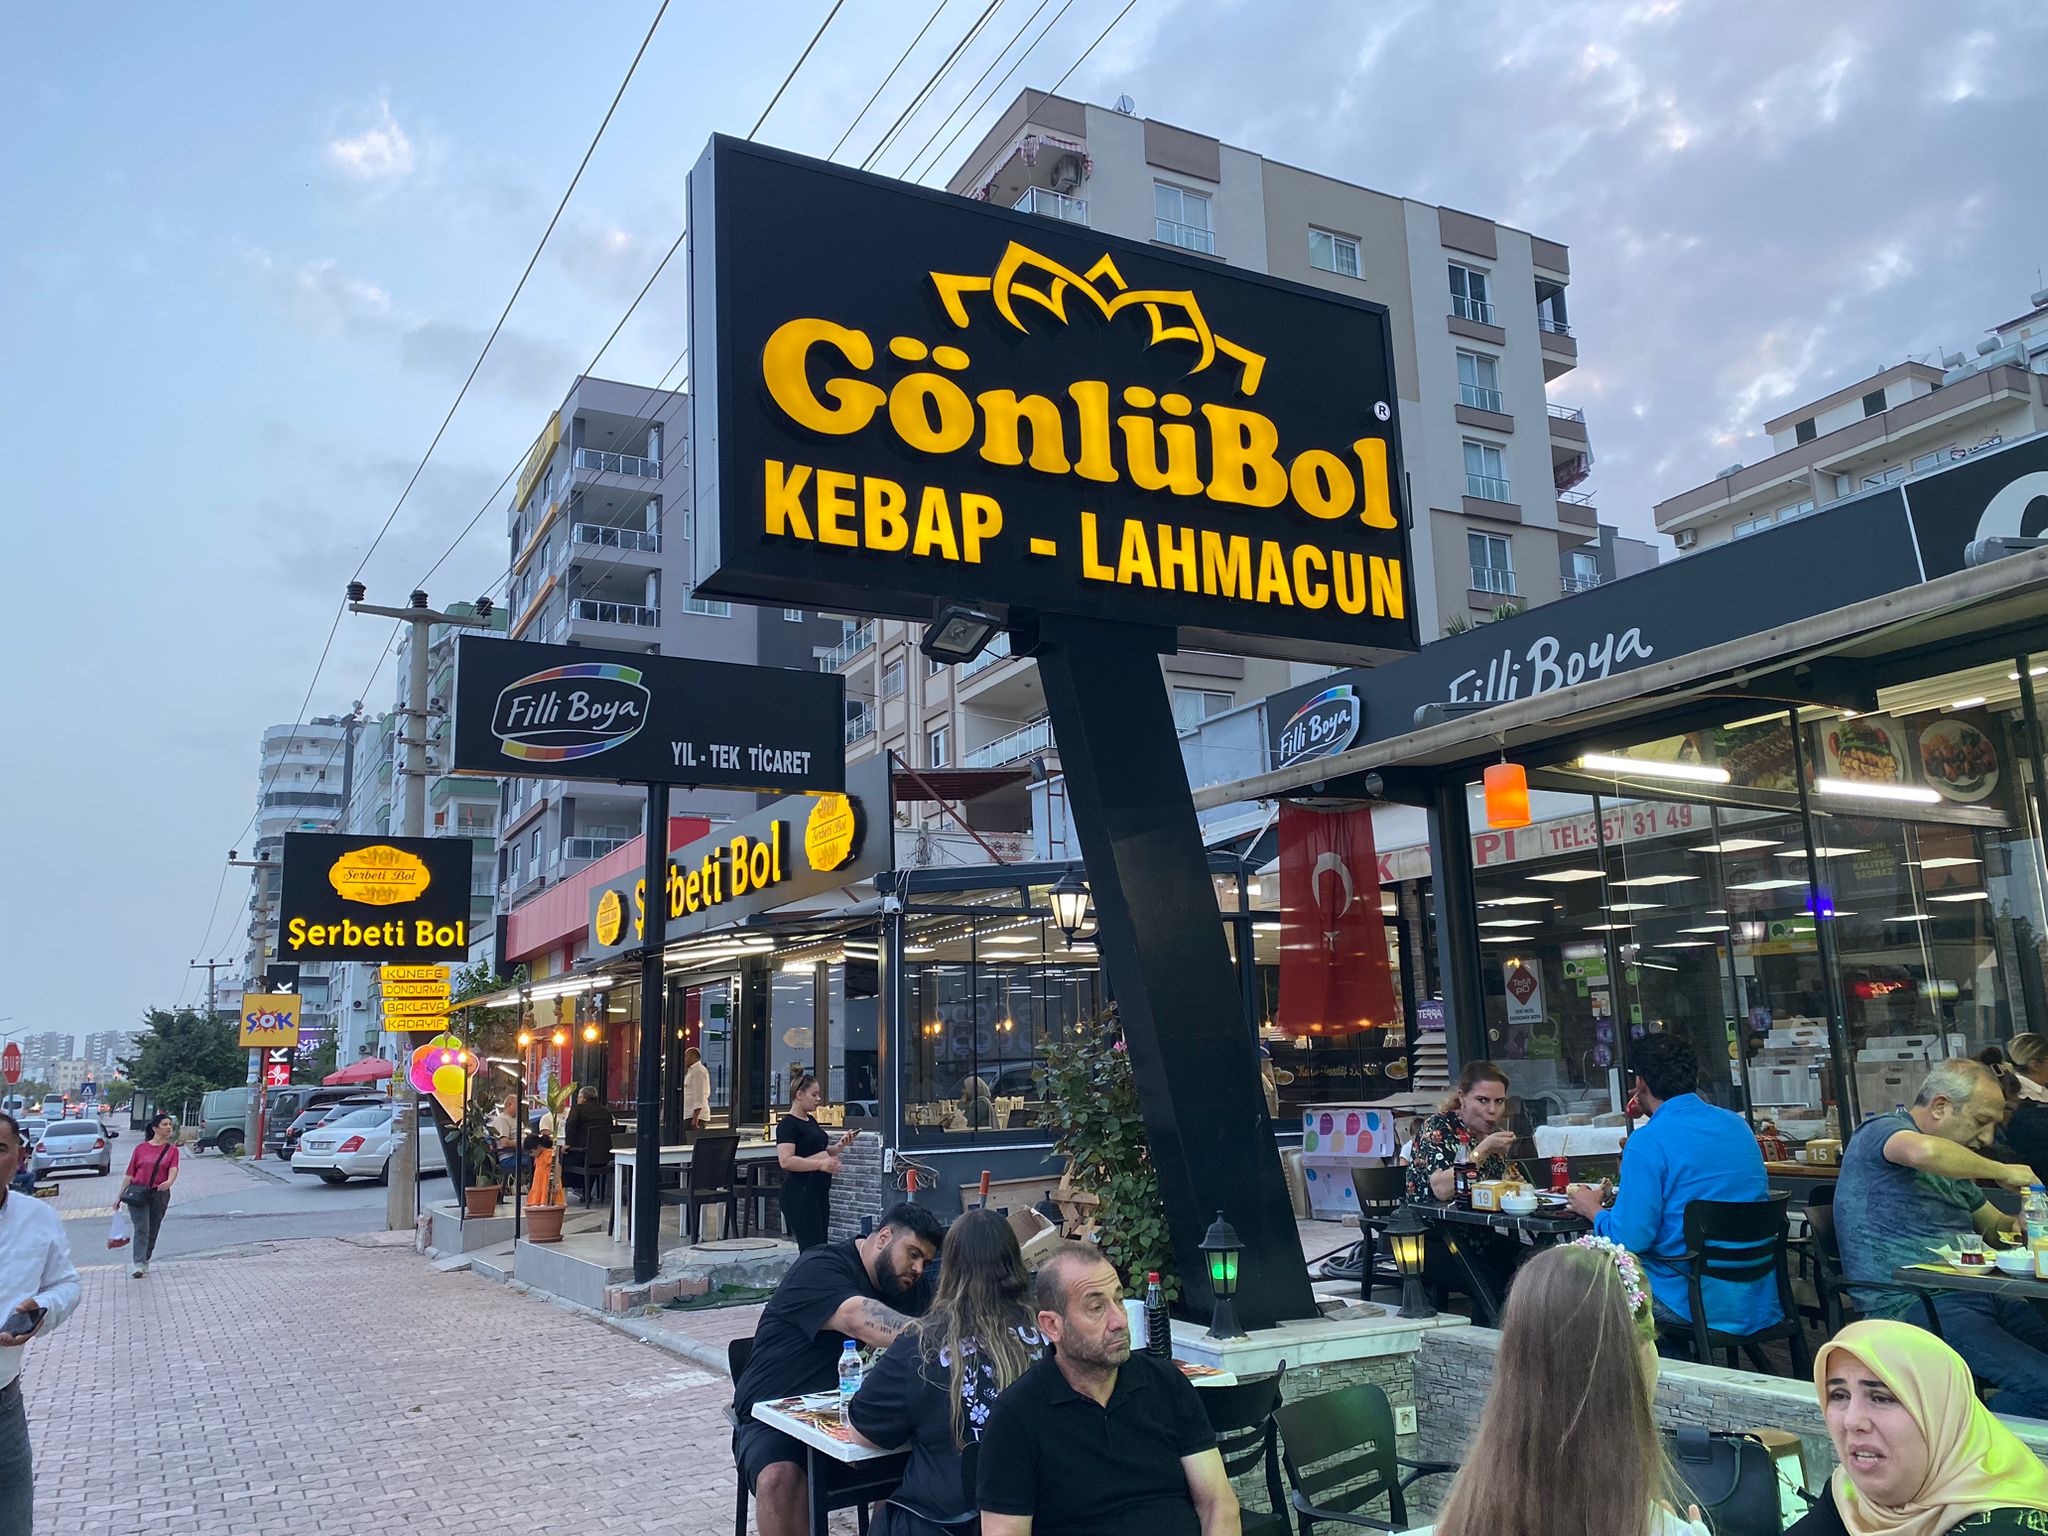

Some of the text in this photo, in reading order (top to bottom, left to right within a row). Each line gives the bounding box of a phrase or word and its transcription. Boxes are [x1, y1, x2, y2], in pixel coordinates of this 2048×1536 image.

[762, 317, 1397, 531] GönlüBol
[764, 459, 1004, 565] KEBAP
[1080, 511, 1404, 621] LAHMACUN
[1449, 627, 1653, 704] Filli Boya
[507, 690, 640, 731] Filli Boya
[1279, 709, 1351, 762] Filli Boya
[671, 741, 697, 766] YIL
[710, 745, 741, 770] TEK
[748, 744, 812, 775] TİCARET
[1634, 809, 1658, 836] 31
[1666, 803, 1693, 829] 49
[391, 871, 416, 881] Bol
[634, 820, 780, 941] Şbeti Bol
[1377, 853, 1395, 881] K
[288, 918, 465, 950] Şerbeti Bol
[386, 967, 443, 979] KÜNEFE
[386, 984, 446, 994] DONDURMA
[387, 1001, 445, 1013] BAKLAVA
[1417, 1008, 1443, 1020] TERRA
[388, 1018, 445, 1029] KADAYIF
[3, 1054, 21, 1072] DUR
[1811, 1148, 1828, 1161] 15
[1478, 1192, 1489, 1204] 19
